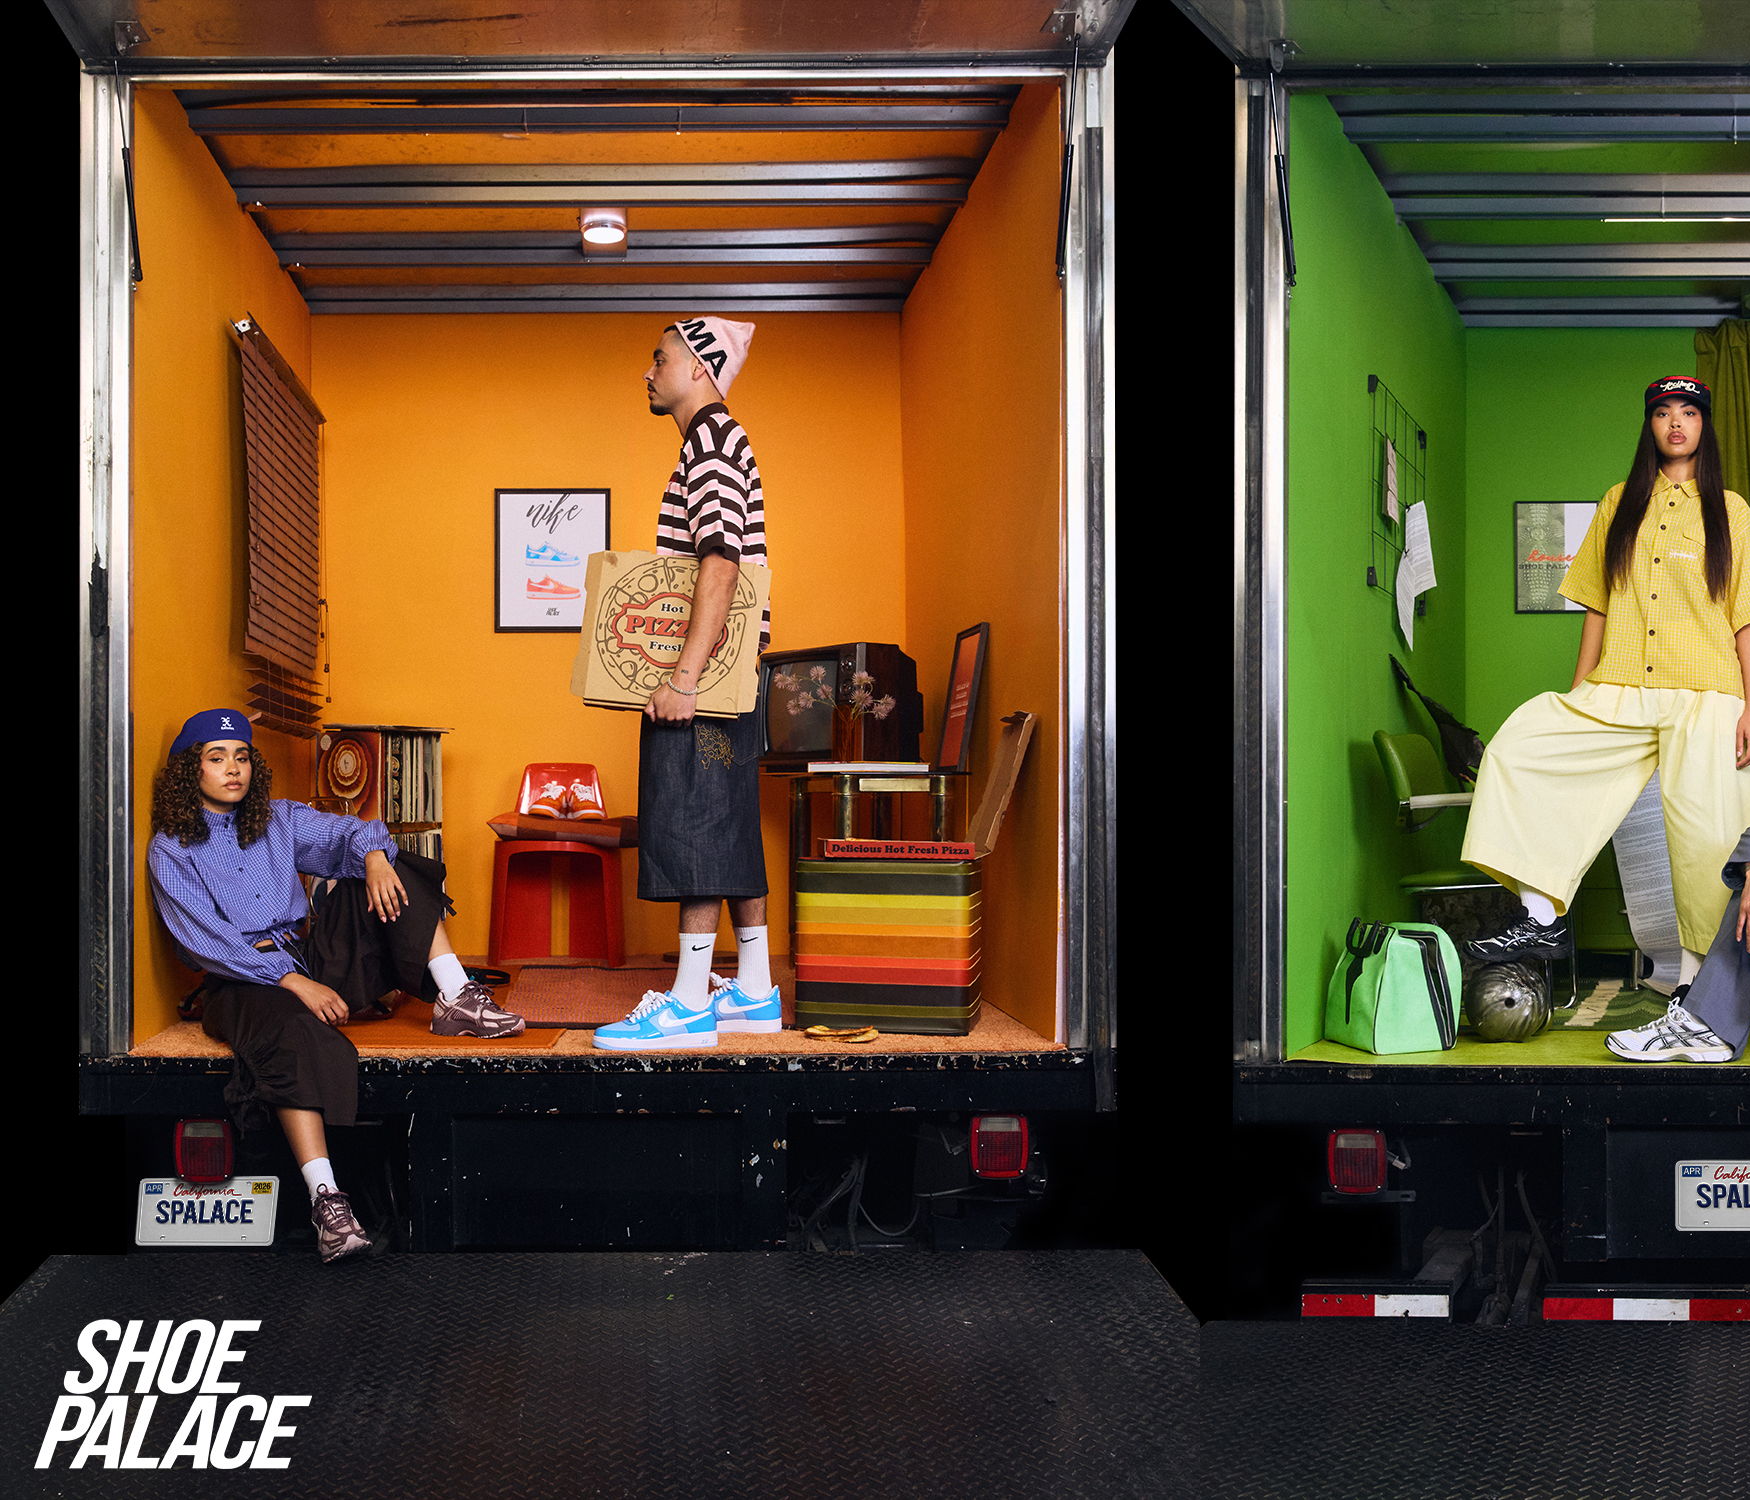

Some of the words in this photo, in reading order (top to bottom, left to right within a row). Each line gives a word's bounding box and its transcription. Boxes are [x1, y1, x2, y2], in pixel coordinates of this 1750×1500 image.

[678, 319, 728, 381] MA
[526, 493, 583, 534] nike
[661, 603, 685, 613] Hot
[624, 615, 690, 638] PIZZ
[831, 844, 882, 853] Delicious
[884, 845, 904, 854] Hot
[908, 845, 939, 854] Fresh
[942, 846, 970, 855] Pizza
[1683, 1167, 1701, 1175] APR
[146, 1184, 162, 1193] APR
[173, 1183, 242, 1200] California
[253, 1182, 272, 1190] 2026
[155, 1199, 254, 1224] SPALACE
